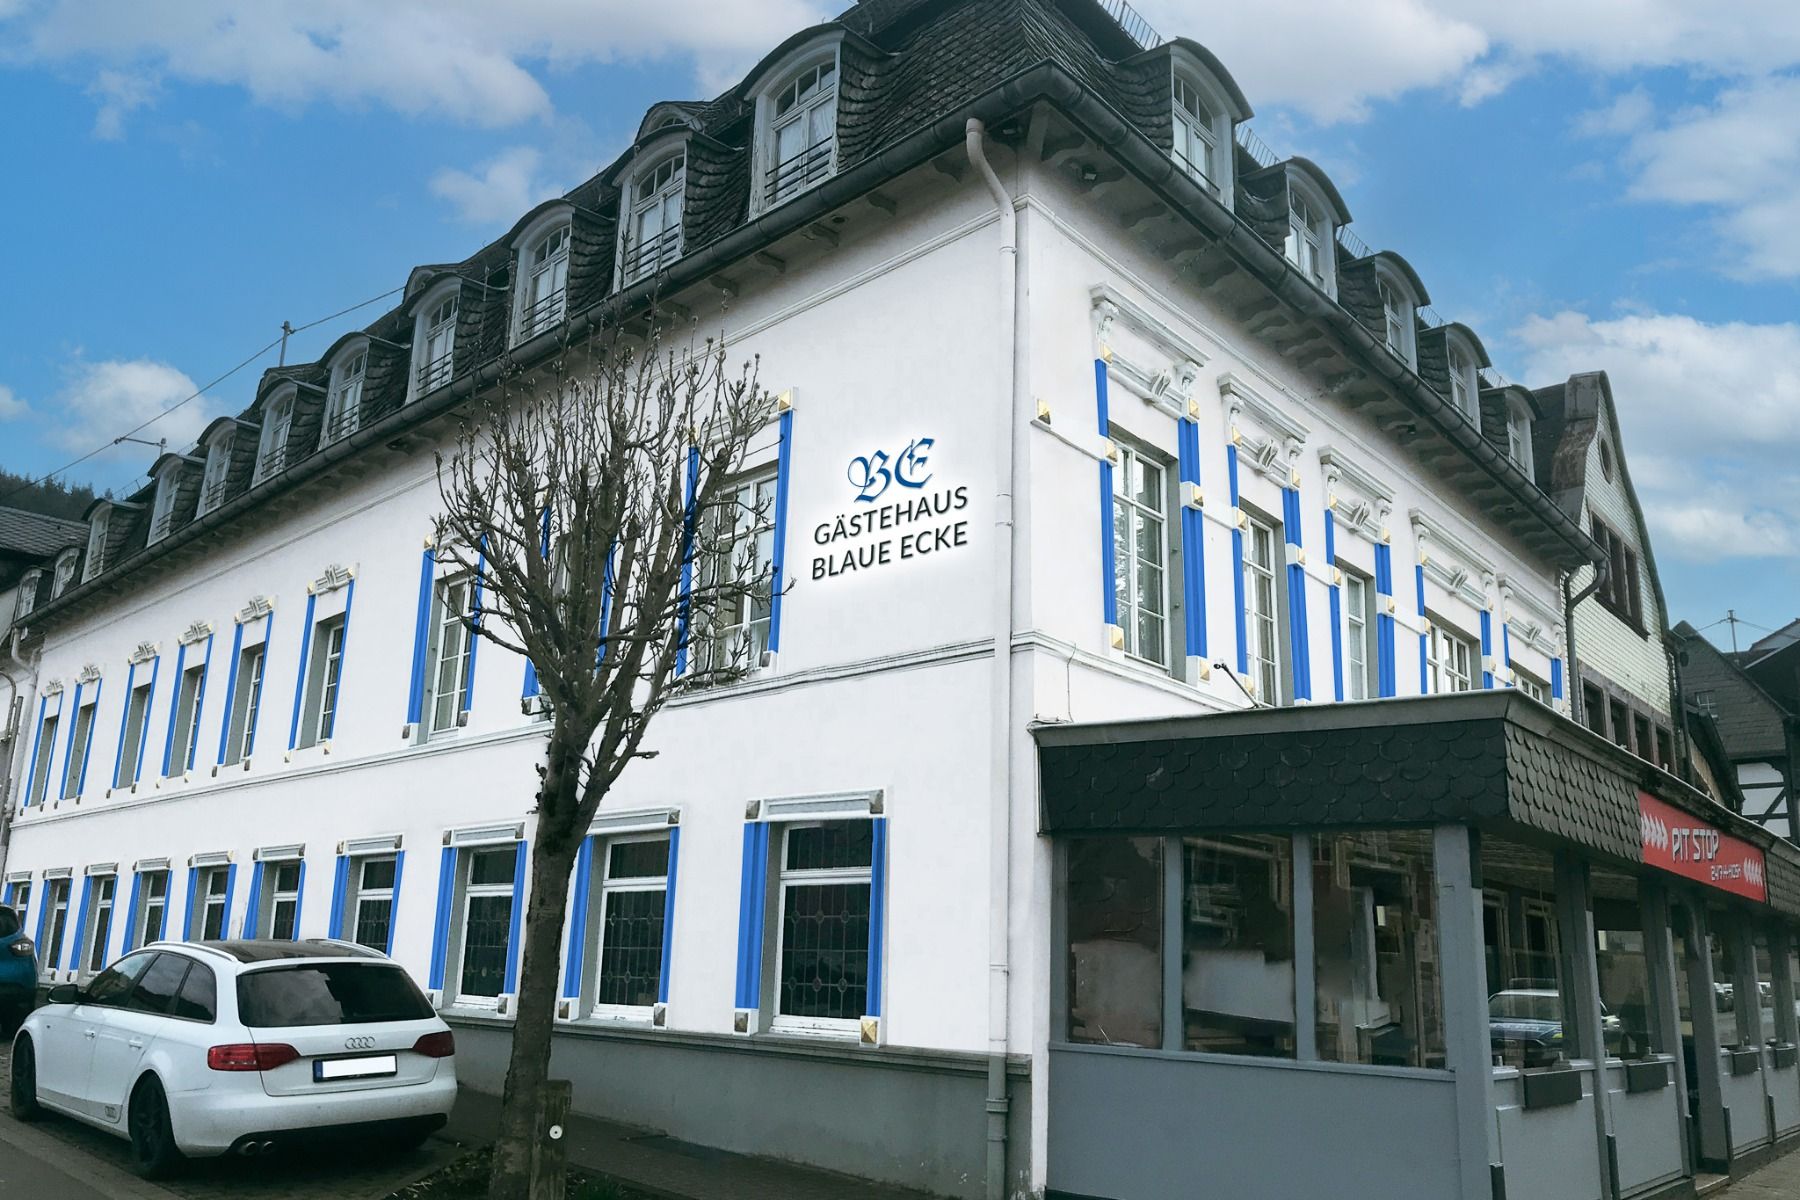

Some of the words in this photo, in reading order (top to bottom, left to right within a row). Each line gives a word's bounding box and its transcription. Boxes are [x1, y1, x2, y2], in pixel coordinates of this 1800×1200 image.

[814, 486, 968, 545] GÄSTEHAUS
[812, 540, 892, 580] BLAUE
[900, 521, 968, 560] ECKE
[1672, 827, 1690, 861] PIT
[1692, 828, 1719, 860] STOP
